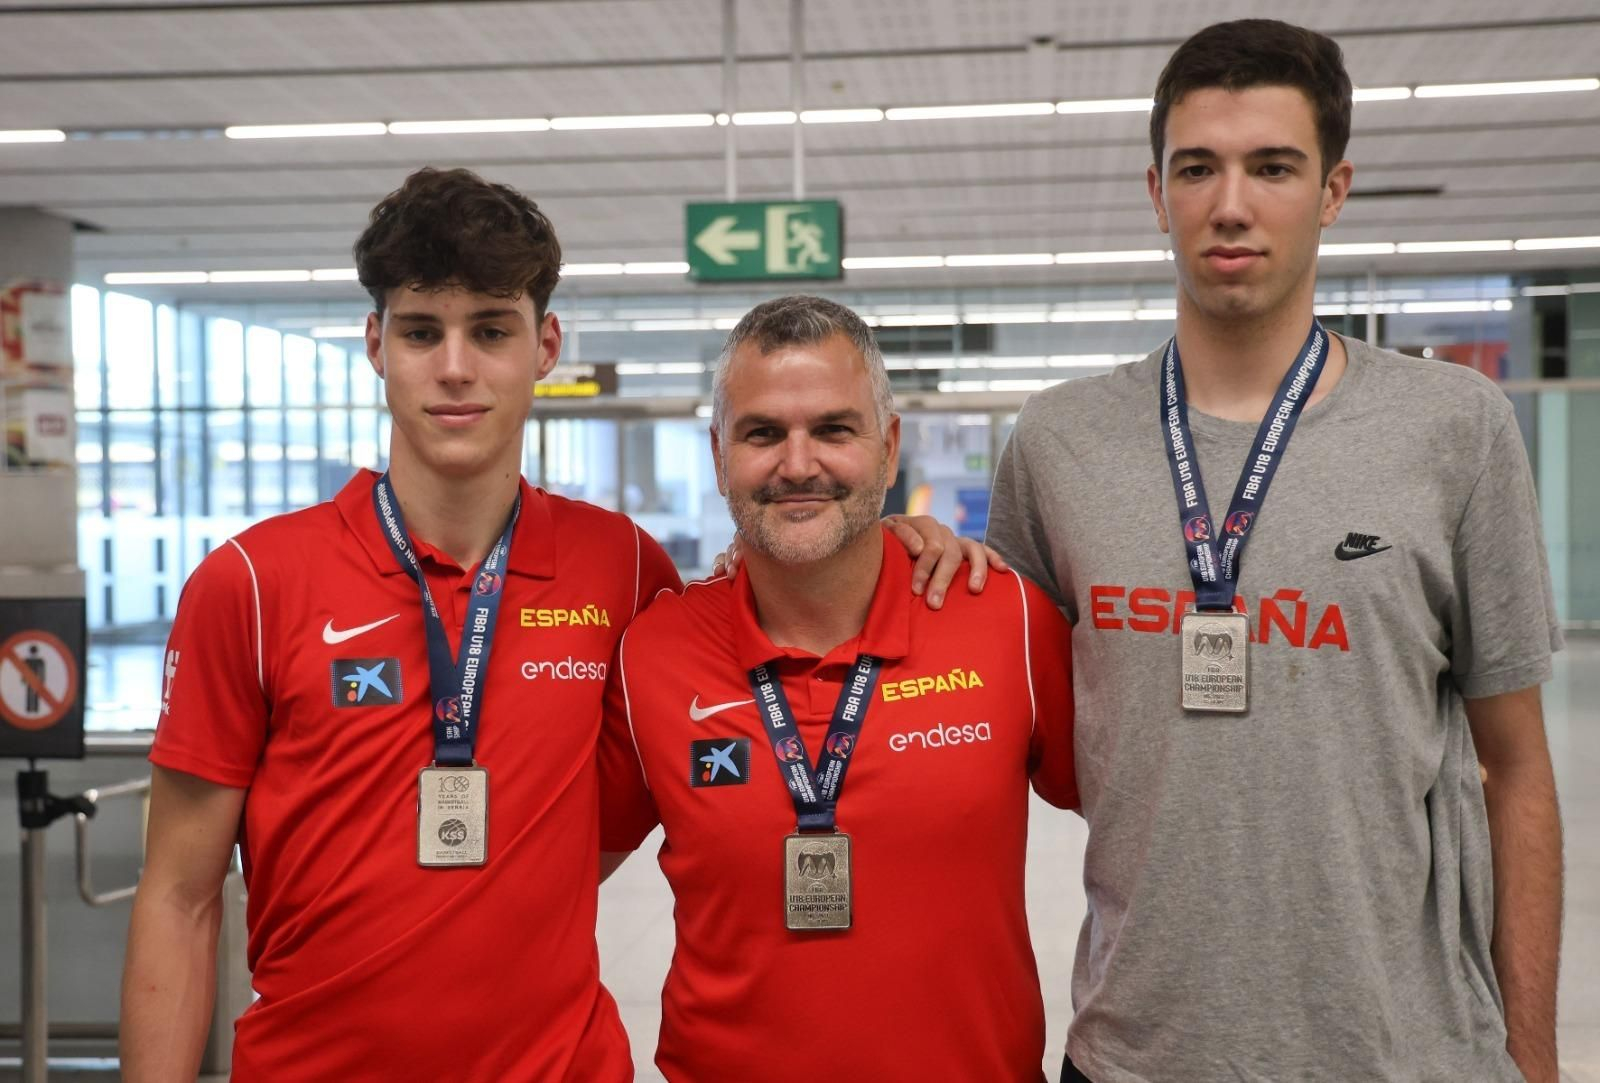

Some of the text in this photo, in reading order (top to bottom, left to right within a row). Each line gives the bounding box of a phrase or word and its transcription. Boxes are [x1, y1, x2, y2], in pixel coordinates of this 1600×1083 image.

[1243, 331, 1324, 500] FIBA U18 EUROPEAN CHAMPIONSHIP
[1168, 404, 1187, 460] EUROPEAN
[1177, 461, 1193, 482] U18
[1182, 481, 1198, 508] FIBA
[377, 482, 407, 551] CHAMPIONSHIP
[1344, 532, 1381, 551] NIKE
[473, 607, 489, 632] FIBA
[520, 604, 611, 628] ESPAÑA
[469, 635, 485, 655] U18
[521, 655, 607, 681] endesa
[1201, 674, 1243, 683] EUROPEAN
[760, 682, 777, 703] U18
[851, 674, 868, 696] U18
[882, 668, 984, 702] ESPAÑA
[1184, 682, 1244, 692] CHAMPIONSHIP
[767, 702, 786, 729] FIBA
[842, 696, 861, 722] FIBA
[889, 722, 991, 752] endesa
[441, 831, 465, 841] KSS
[789, 903, 848, 912] CHAMPIONSHIP
[805, 894, 847, 902] EUROPEAN
